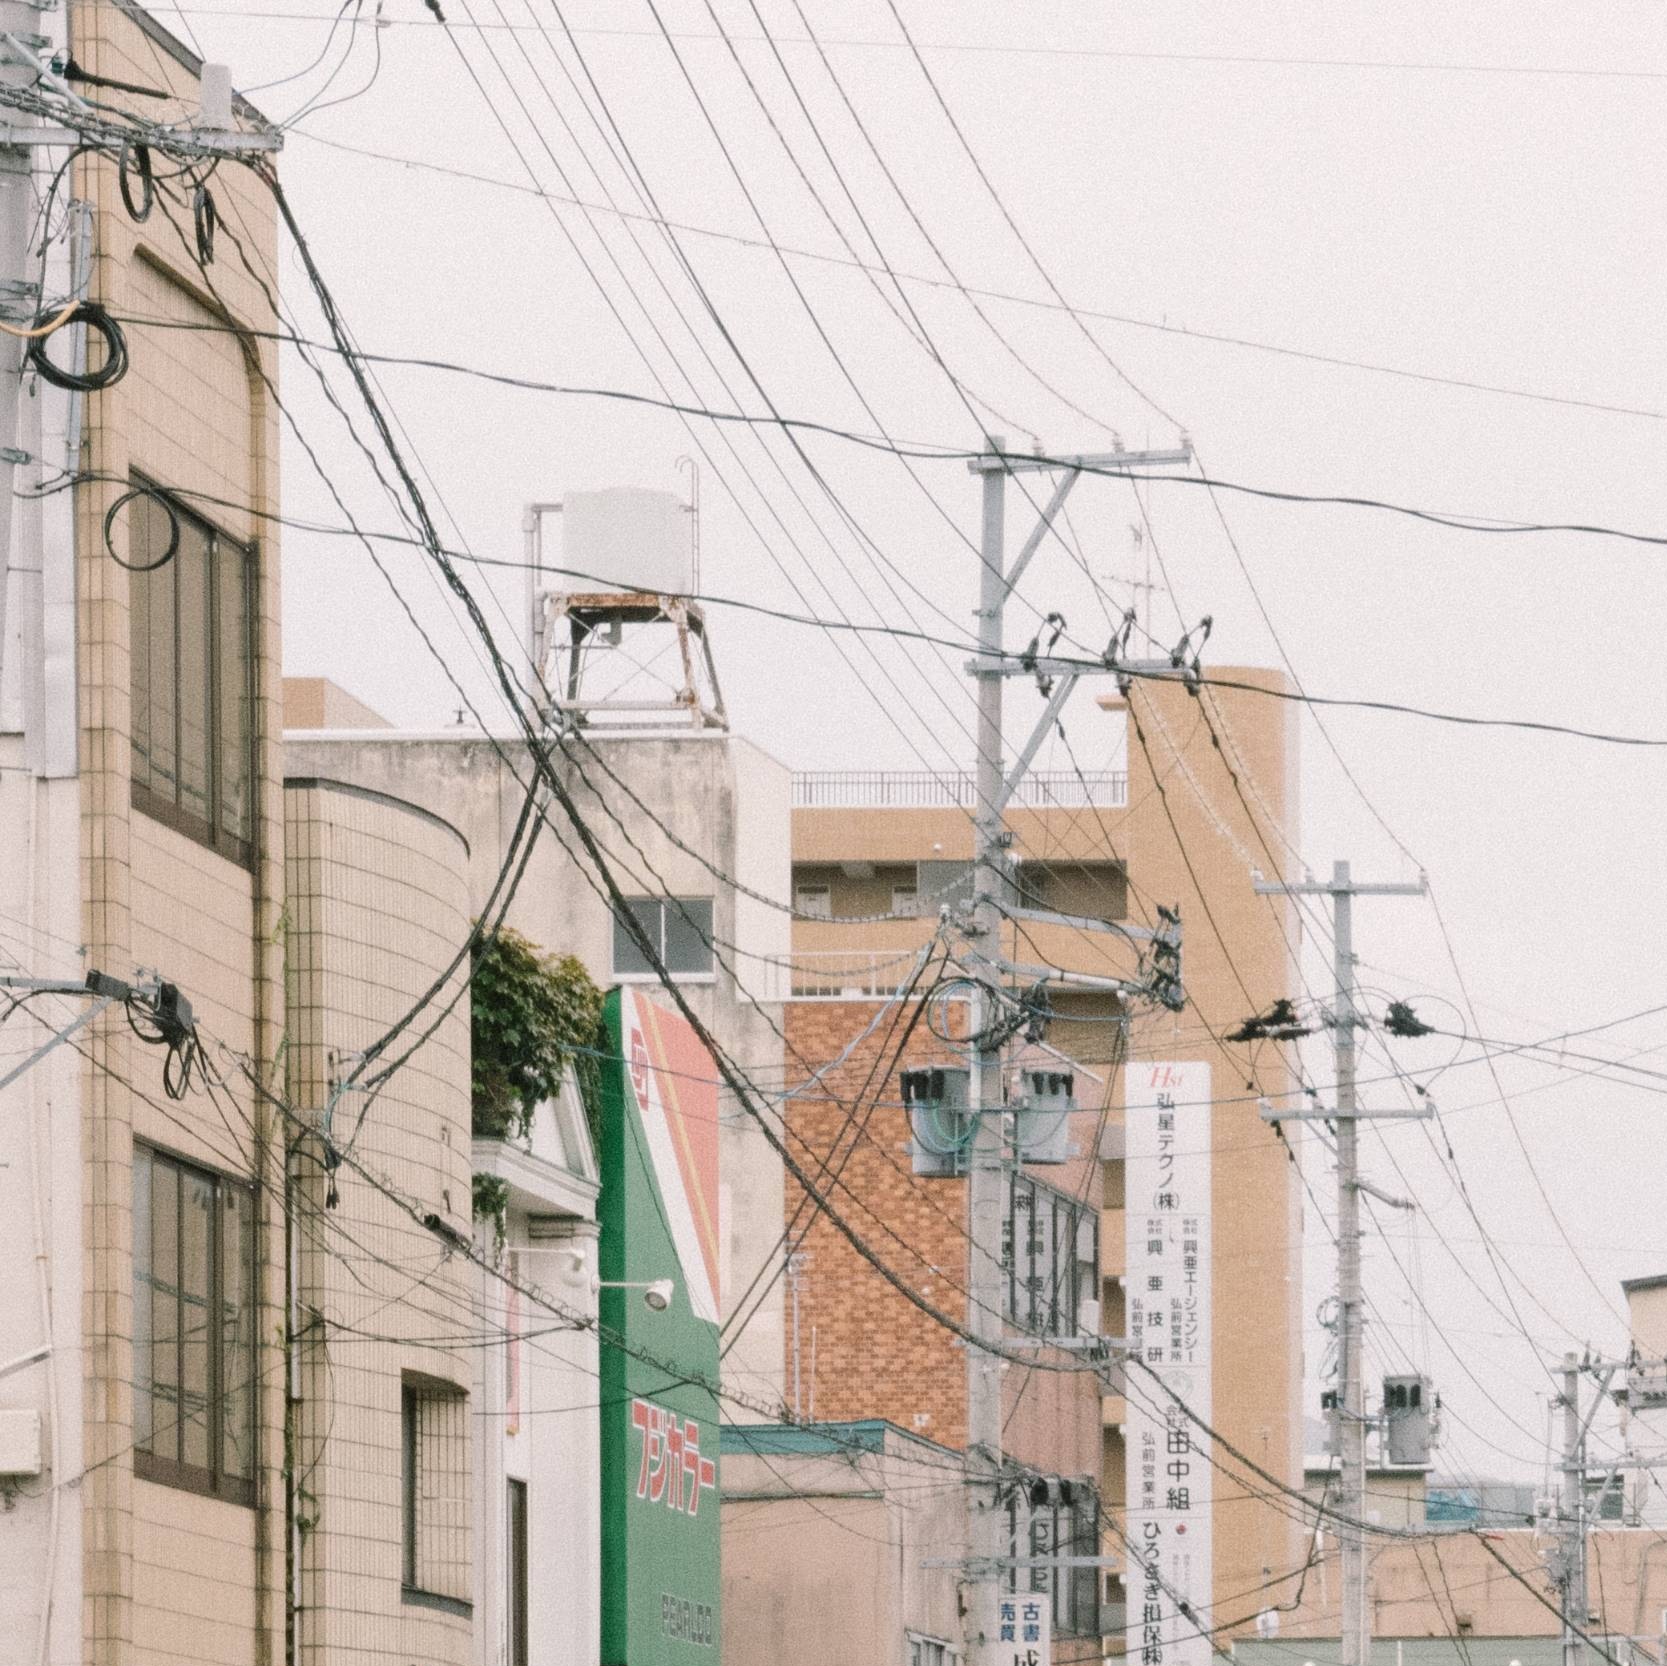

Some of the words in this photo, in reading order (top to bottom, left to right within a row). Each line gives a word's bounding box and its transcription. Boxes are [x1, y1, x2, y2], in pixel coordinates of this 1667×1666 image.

[631, 1397, 716, 1516] フジカラー
